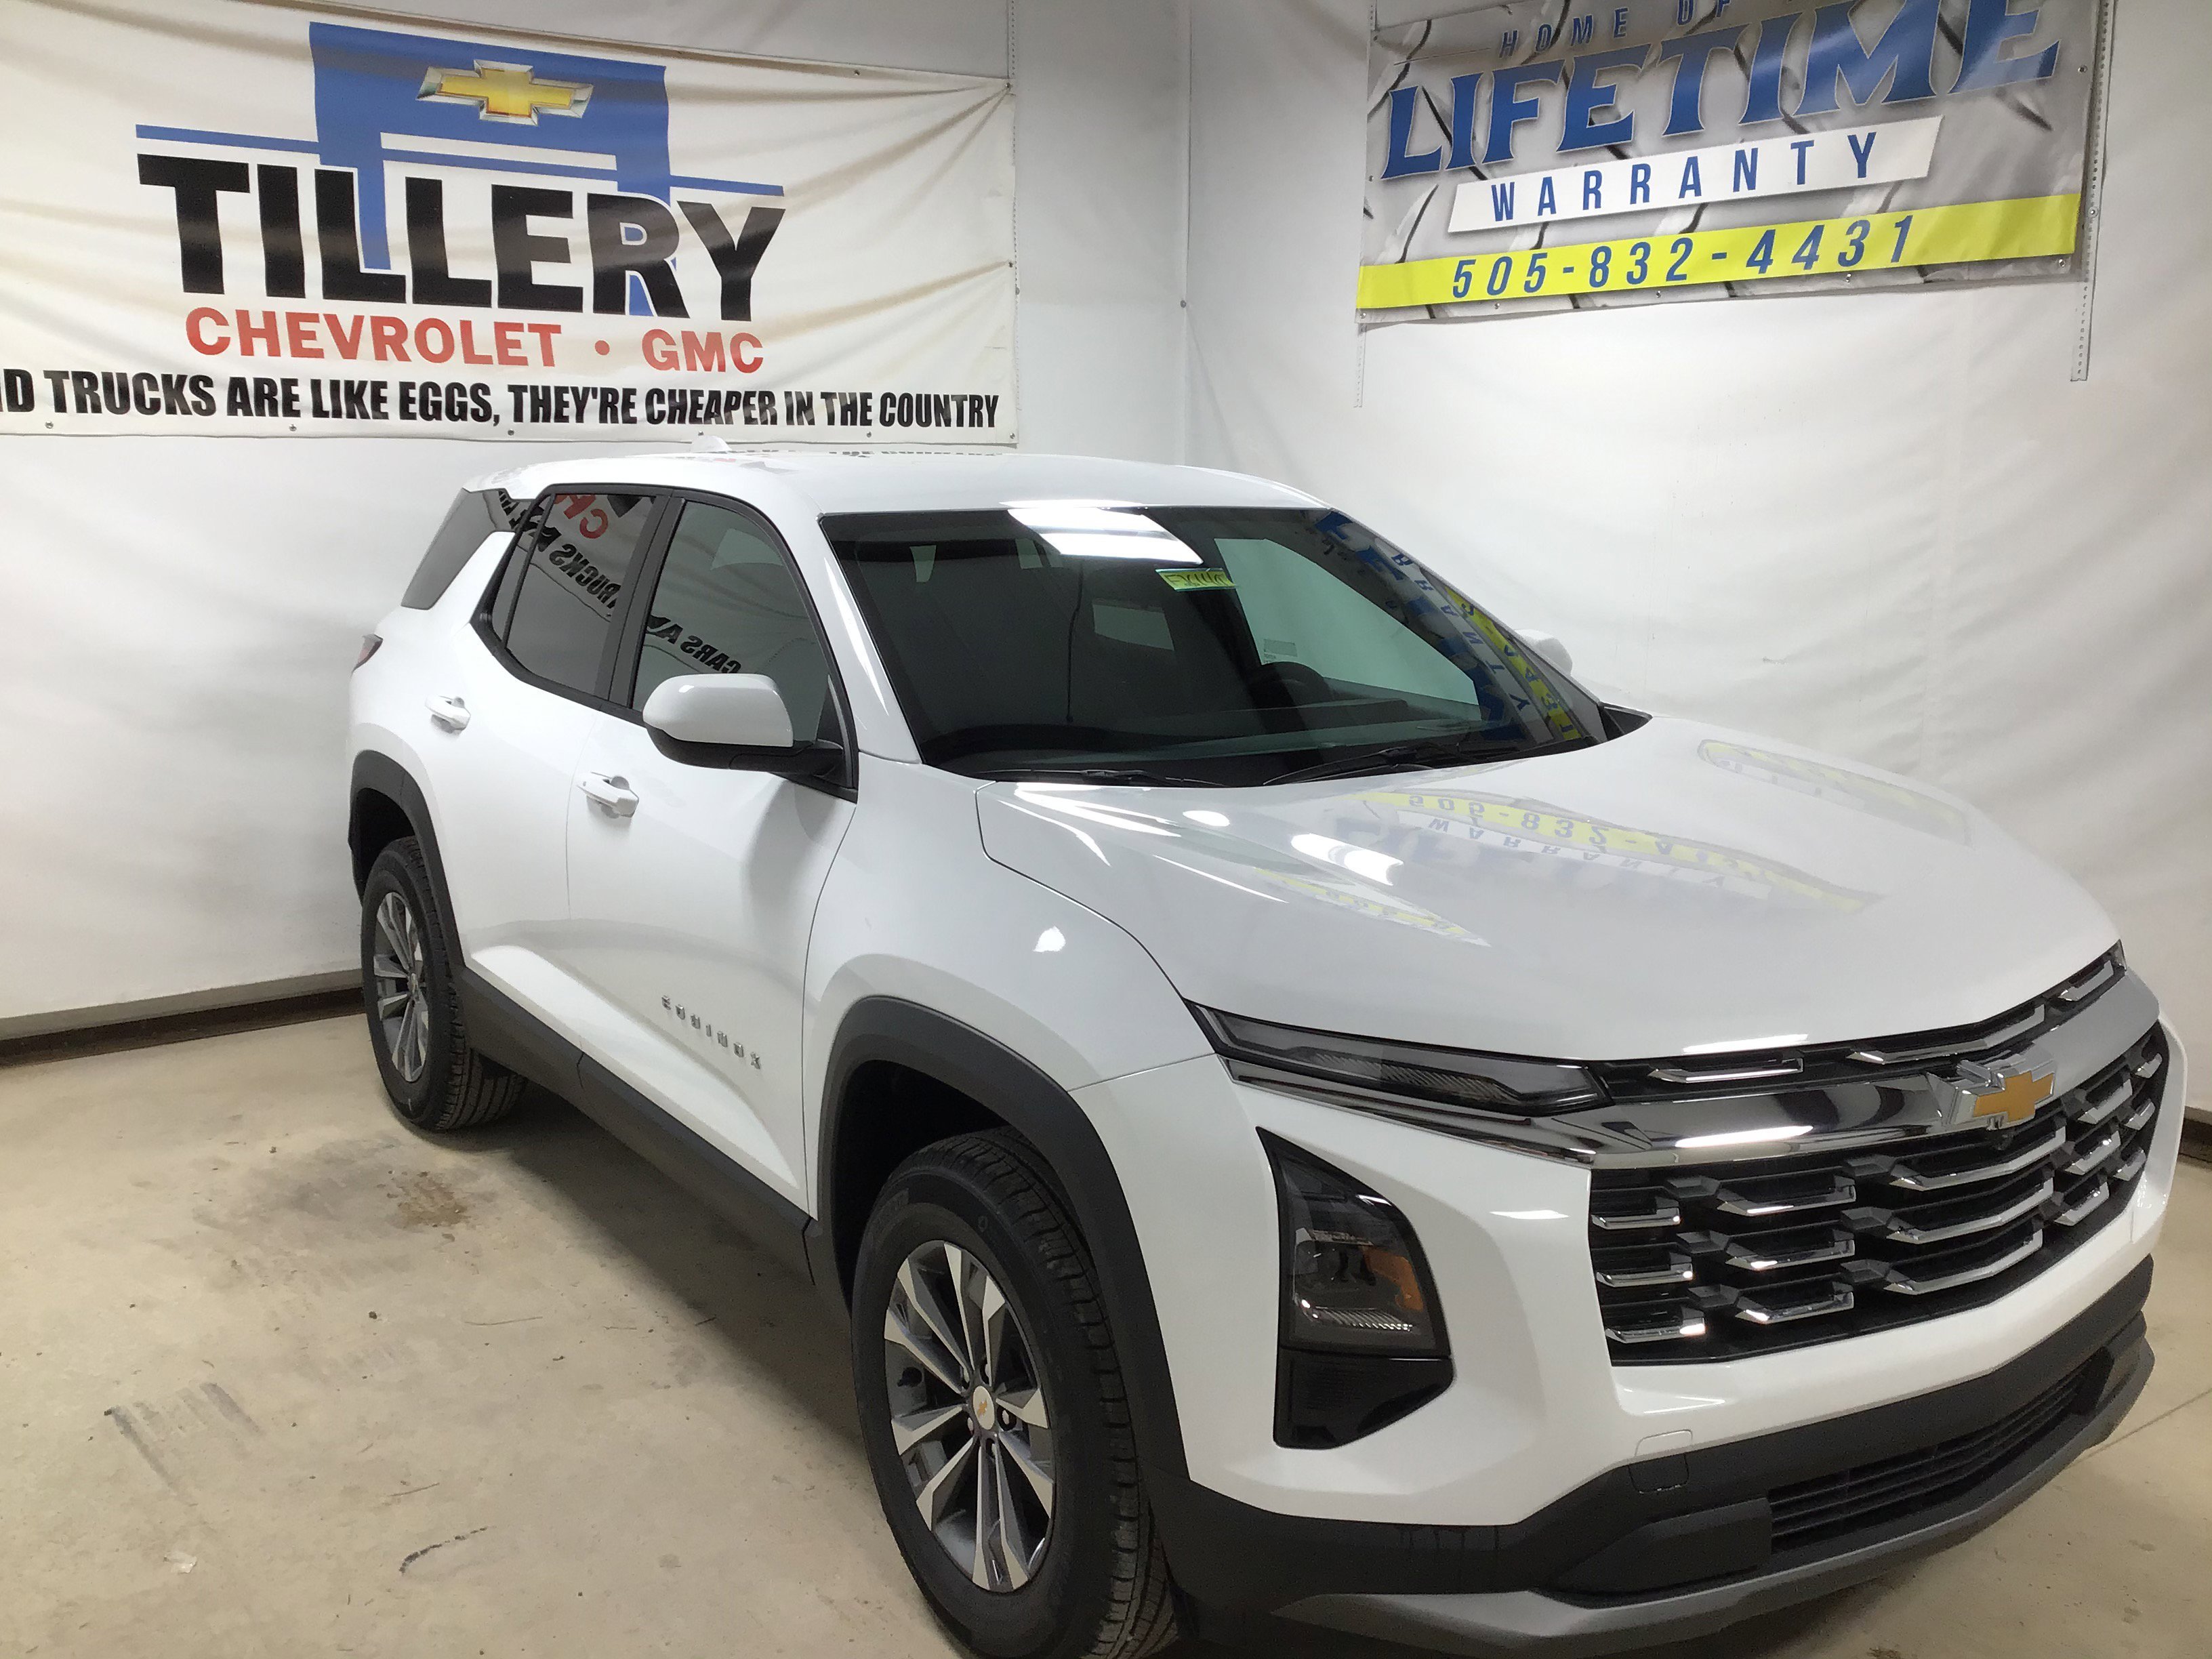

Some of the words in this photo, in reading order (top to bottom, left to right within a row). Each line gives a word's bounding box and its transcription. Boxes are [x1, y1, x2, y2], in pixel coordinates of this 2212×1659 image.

[1499, 8, 1629, 58] HOME
[1380, 0, 2059, 179] LIFETIME
[1491, 132, 1877, 222] WARRANTY
[138, 154, 785, 321] TILLERY
[1452, 216, 1913, 298] 505-832-4431
[186, 307, 561, 367] CHEVROLET
[642, 329, 764, 373] GMC
[44, 370, 213, 417] TRUCKS
[226, 377, 300, 419] ARE
[310, 379, 388, 419] LIKE
[398, 382, 501, 426] EGGS,
[508, 385, 636, 424] THEY'RE
[645, 388, 777, 426] CHEAPER
[784, 391, 815, 426] IN
[820, 392, 873, 427] THE
[879, 392, 999, 428] COUNTRY
